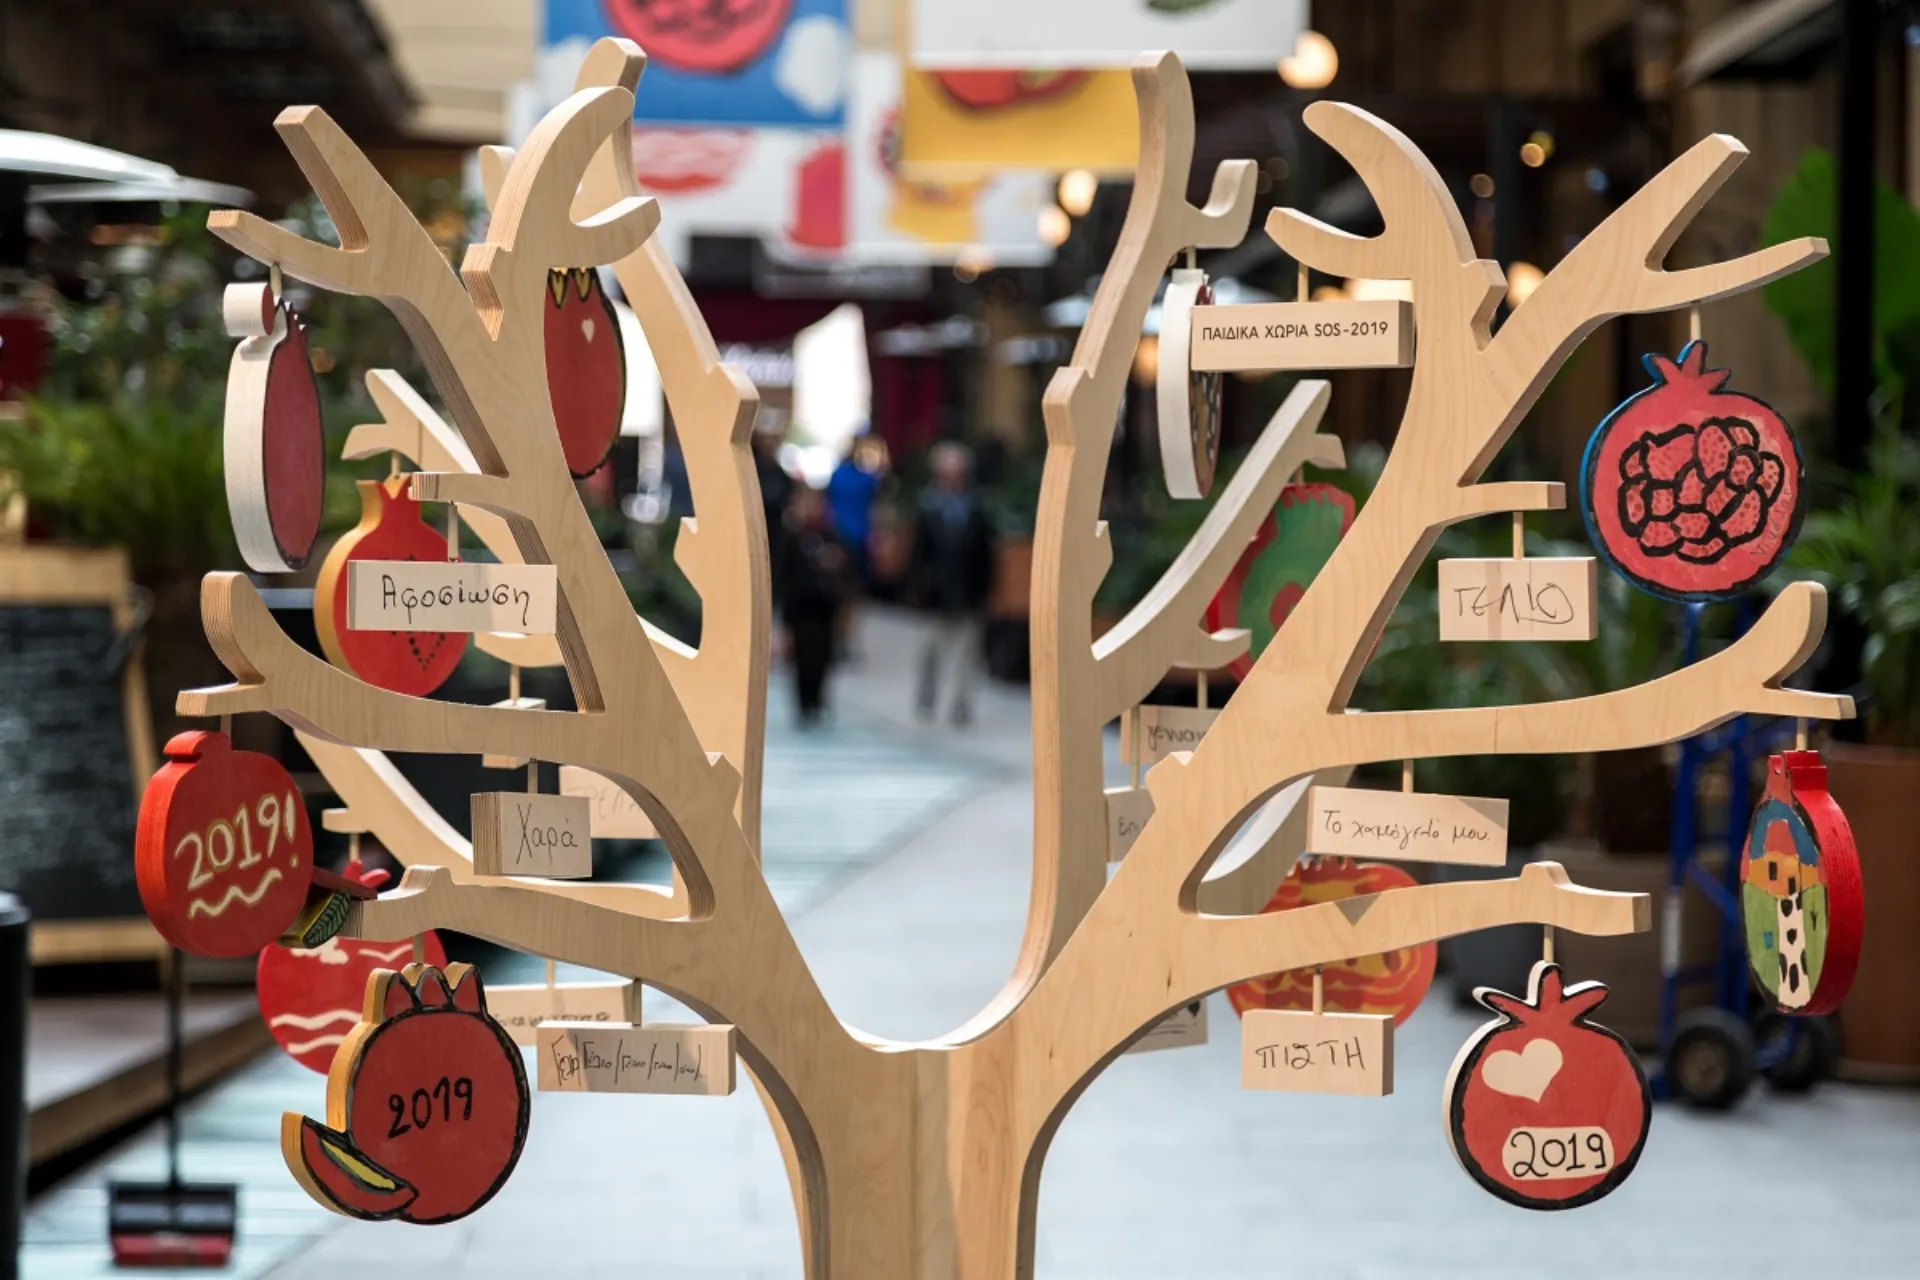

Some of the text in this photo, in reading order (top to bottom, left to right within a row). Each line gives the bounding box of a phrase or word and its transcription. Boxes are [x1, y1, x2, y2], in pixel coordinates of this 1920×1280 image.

[1202, 320, 1389, 341] ΠΑΙΔΙΚΑ ΧΩΡΙΑ SOS-2019
[173, 790, 299, 893] 2019!
[1323, 809, 1343, 834] Το
[386, 1075, 473, 1139] 2019
[1509, 1130, 1608, 1178] 2019
